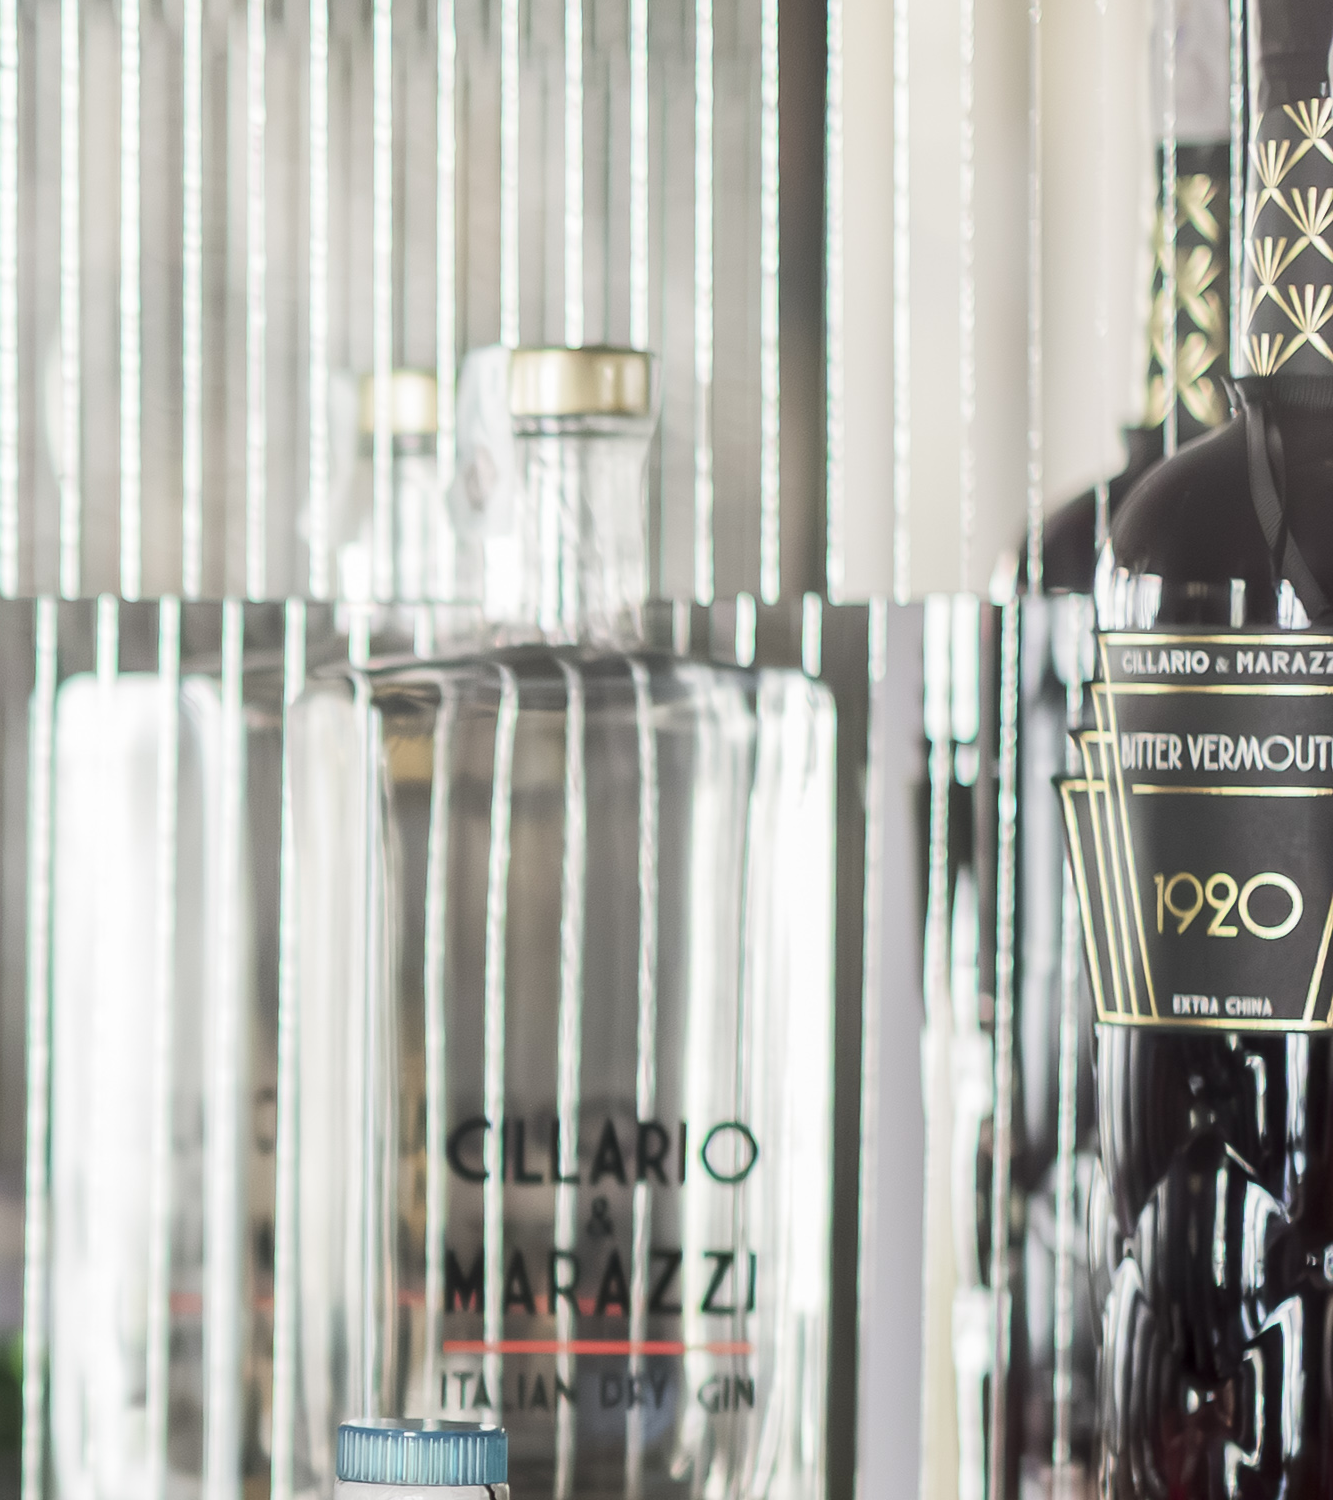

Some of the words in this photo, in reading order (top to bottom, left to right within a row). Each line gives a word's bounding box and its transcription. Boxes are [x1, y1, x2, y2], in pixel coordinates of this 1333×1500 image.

[1122, 649, 1210, 674] CILLARIO
[1120, 731, 1183, 771] BITTER
[1186, 733, 1333, 772] VERMOUT
[1154, 872, 1303, 940] 1920
[1172, 994, 1219, 1015] EXTRA
[1225, 996, 1273, 1017] CHINA
[446, 1117, 758, 1186] CILLARIO
[585, 1197, 614, 1236] &
[445, 1249, 757, 1315] MARAZZI
[439, 1372, 579, 1411] ITALIAN
[600, 1372, 669, 1411] DRY
[697, 1376, 756, 1414] GIN
